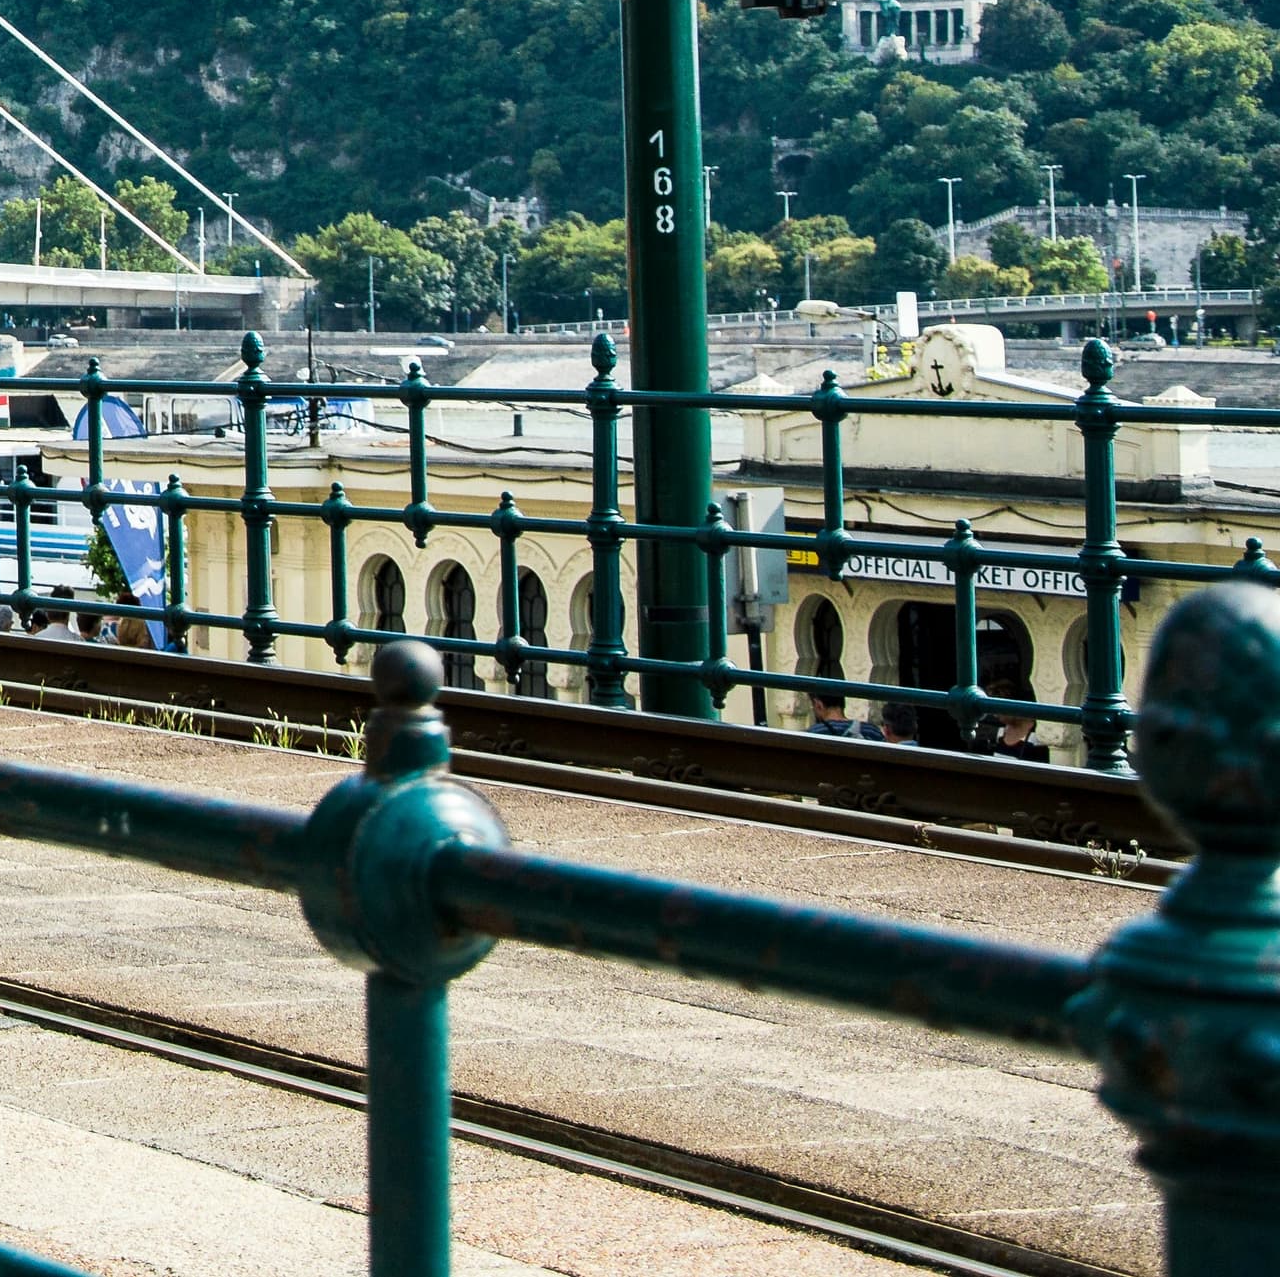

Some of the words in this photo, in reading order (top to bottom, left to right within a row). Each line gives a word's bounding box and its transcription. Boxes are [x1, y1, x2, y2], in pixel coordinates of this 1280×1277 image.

[648, 129, 675, 234] 168
[847, 554, 936, 581] OFFICIAL
[942, 561, 1016, 587] TKET
[1022, 568, 1087, 593] OFFIC
